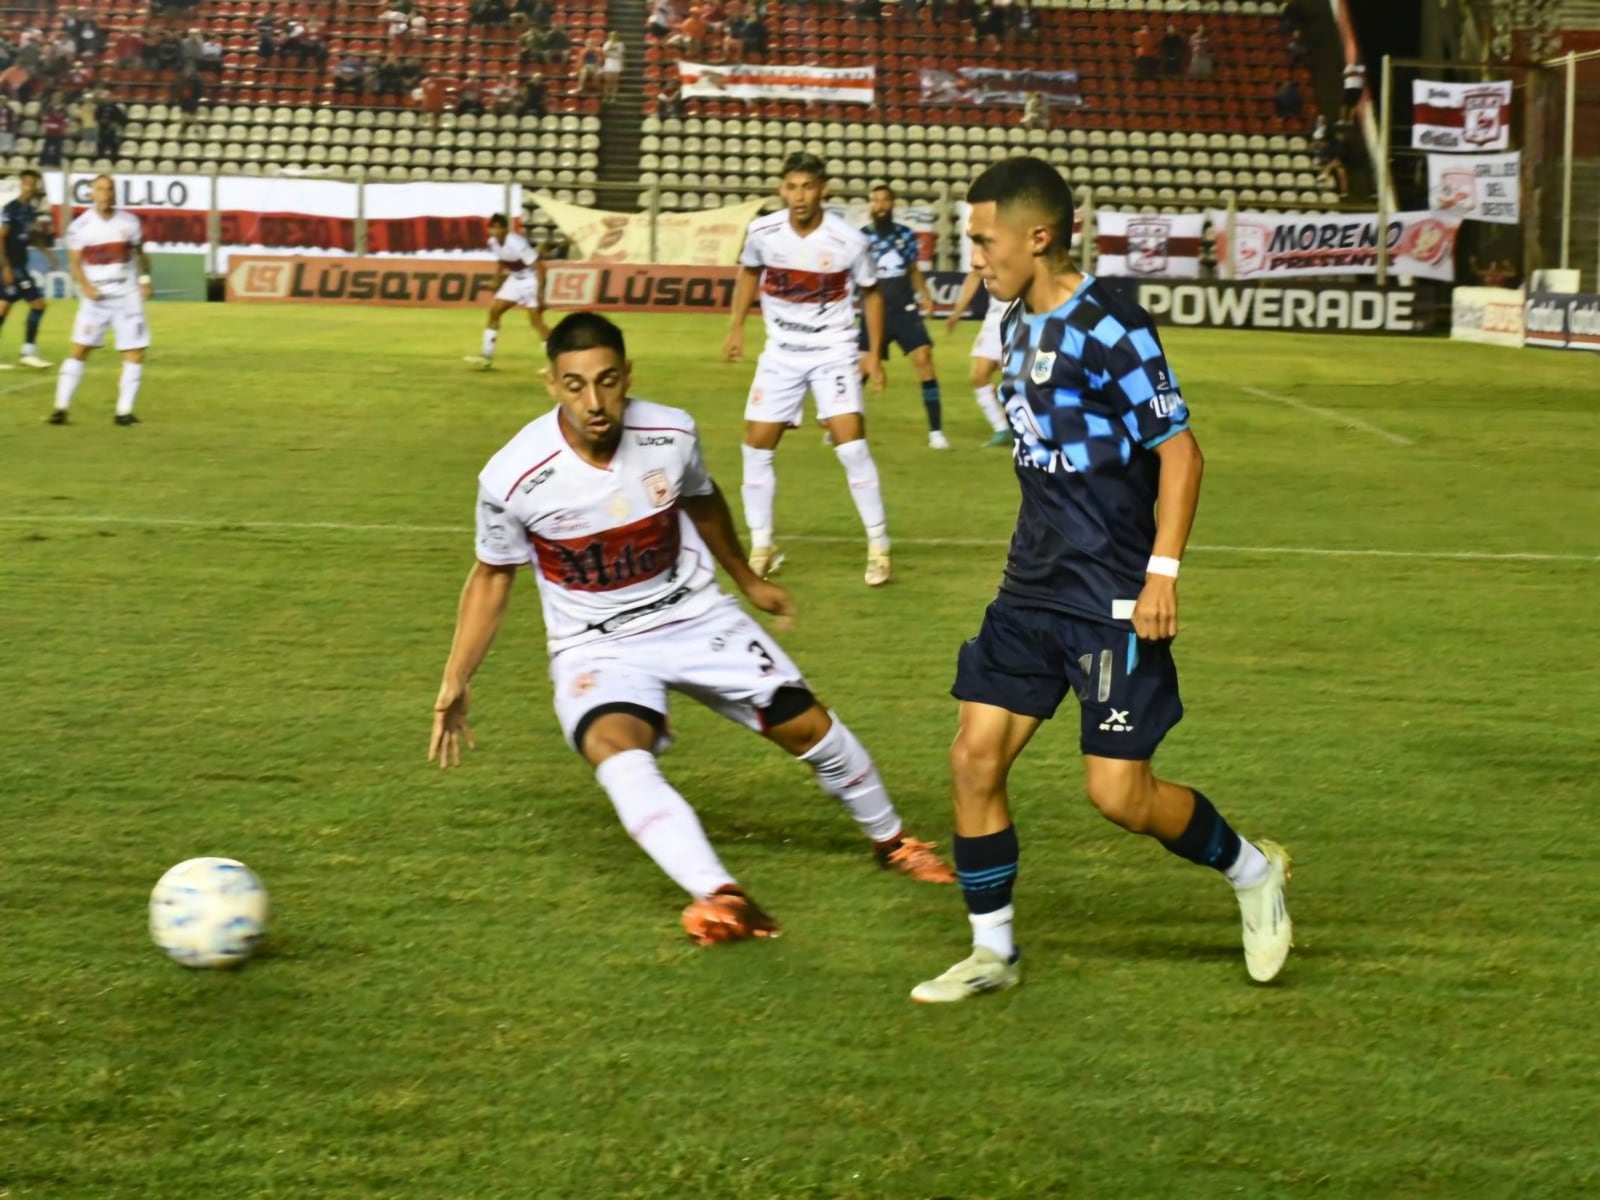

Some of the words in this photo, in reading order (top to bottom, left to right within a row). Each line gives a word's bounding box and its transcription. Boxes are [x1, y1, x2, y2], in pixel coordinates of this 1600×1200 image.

[73, 178, 188, 207] GLLO
[1267, 221, 1403, 253] MORENO
[1138, 284, 1415, 331] POWERADE
[835, 376, 848, 395] 5
[747, 640, 776, 674] 3
